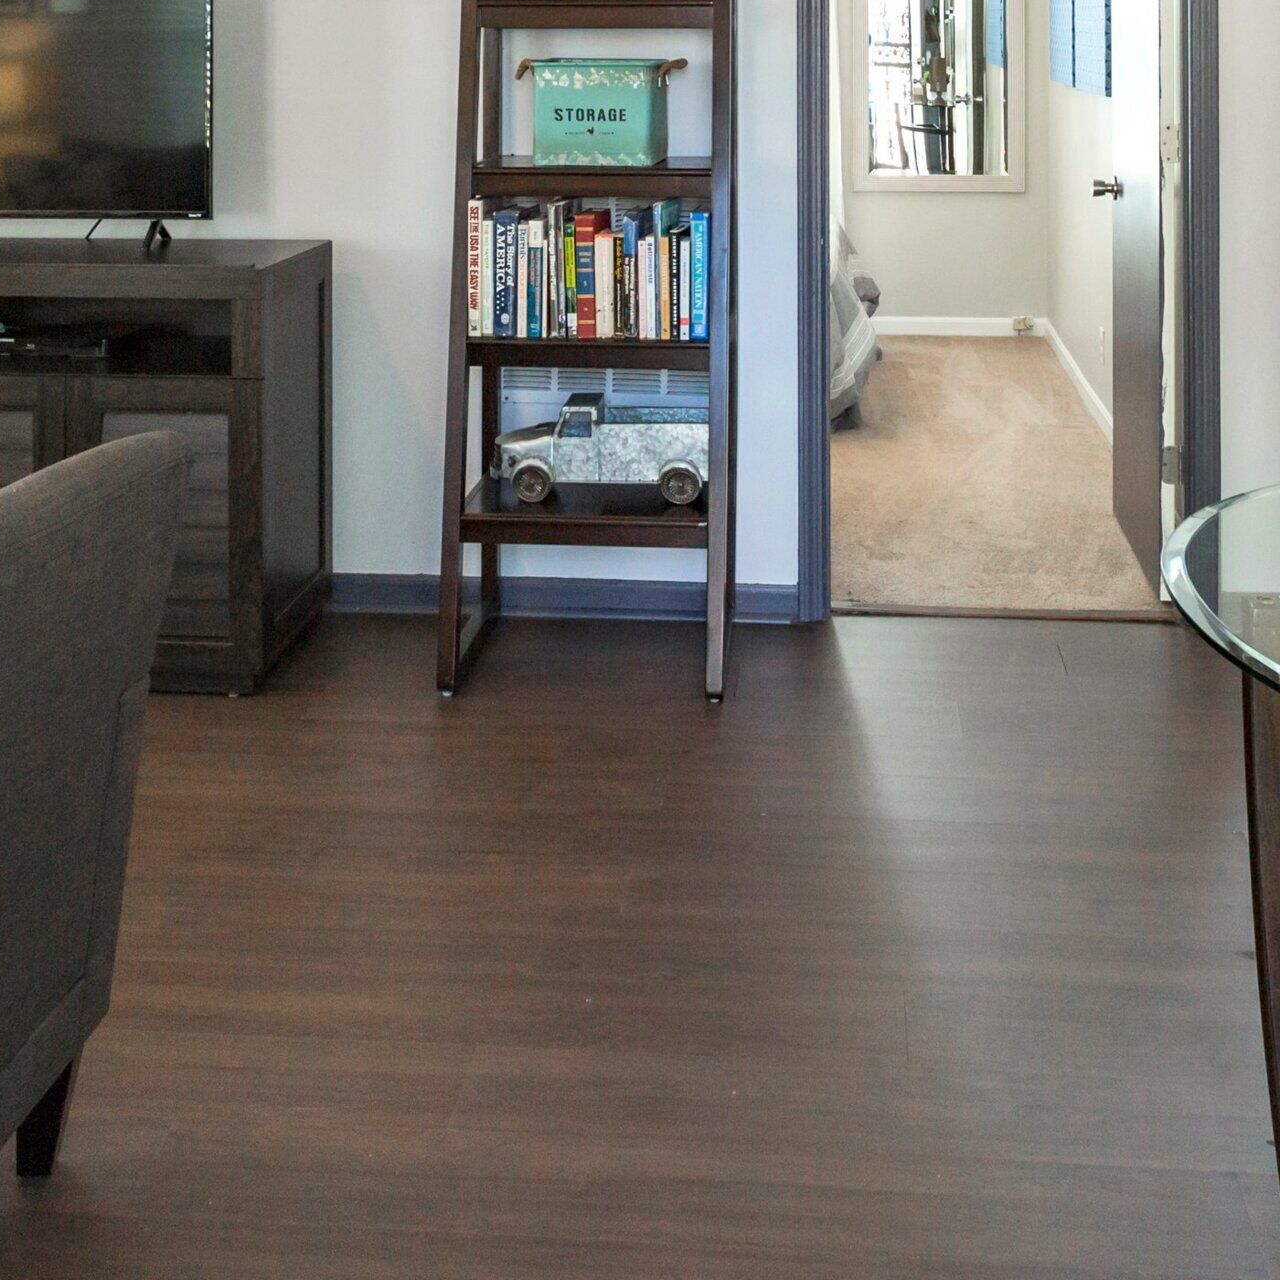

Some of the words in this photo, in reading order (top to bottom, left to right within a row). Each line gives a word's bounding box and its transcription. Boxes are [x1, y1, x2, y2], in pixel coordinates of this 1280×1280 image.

[554, 107, 627, 122] STORAGE
[470, 206, 479, 221] SEE
[470, 222, 479, 234] THE
[506, 223, 515, 244] The
[470, 235, 479, 252] USA
[695, 231, 703, 274] AMERICAN
[470, 253, 479, 269] THE
[496, 223, 505, 292] AMERICA
[505, 245, 515, 274] Story
[470, 270, 479, 291] EASY
[506, 276, 514, 287] of
[470, 292, 479, 310] WAY
[694, 276, 703, 308] NATION
